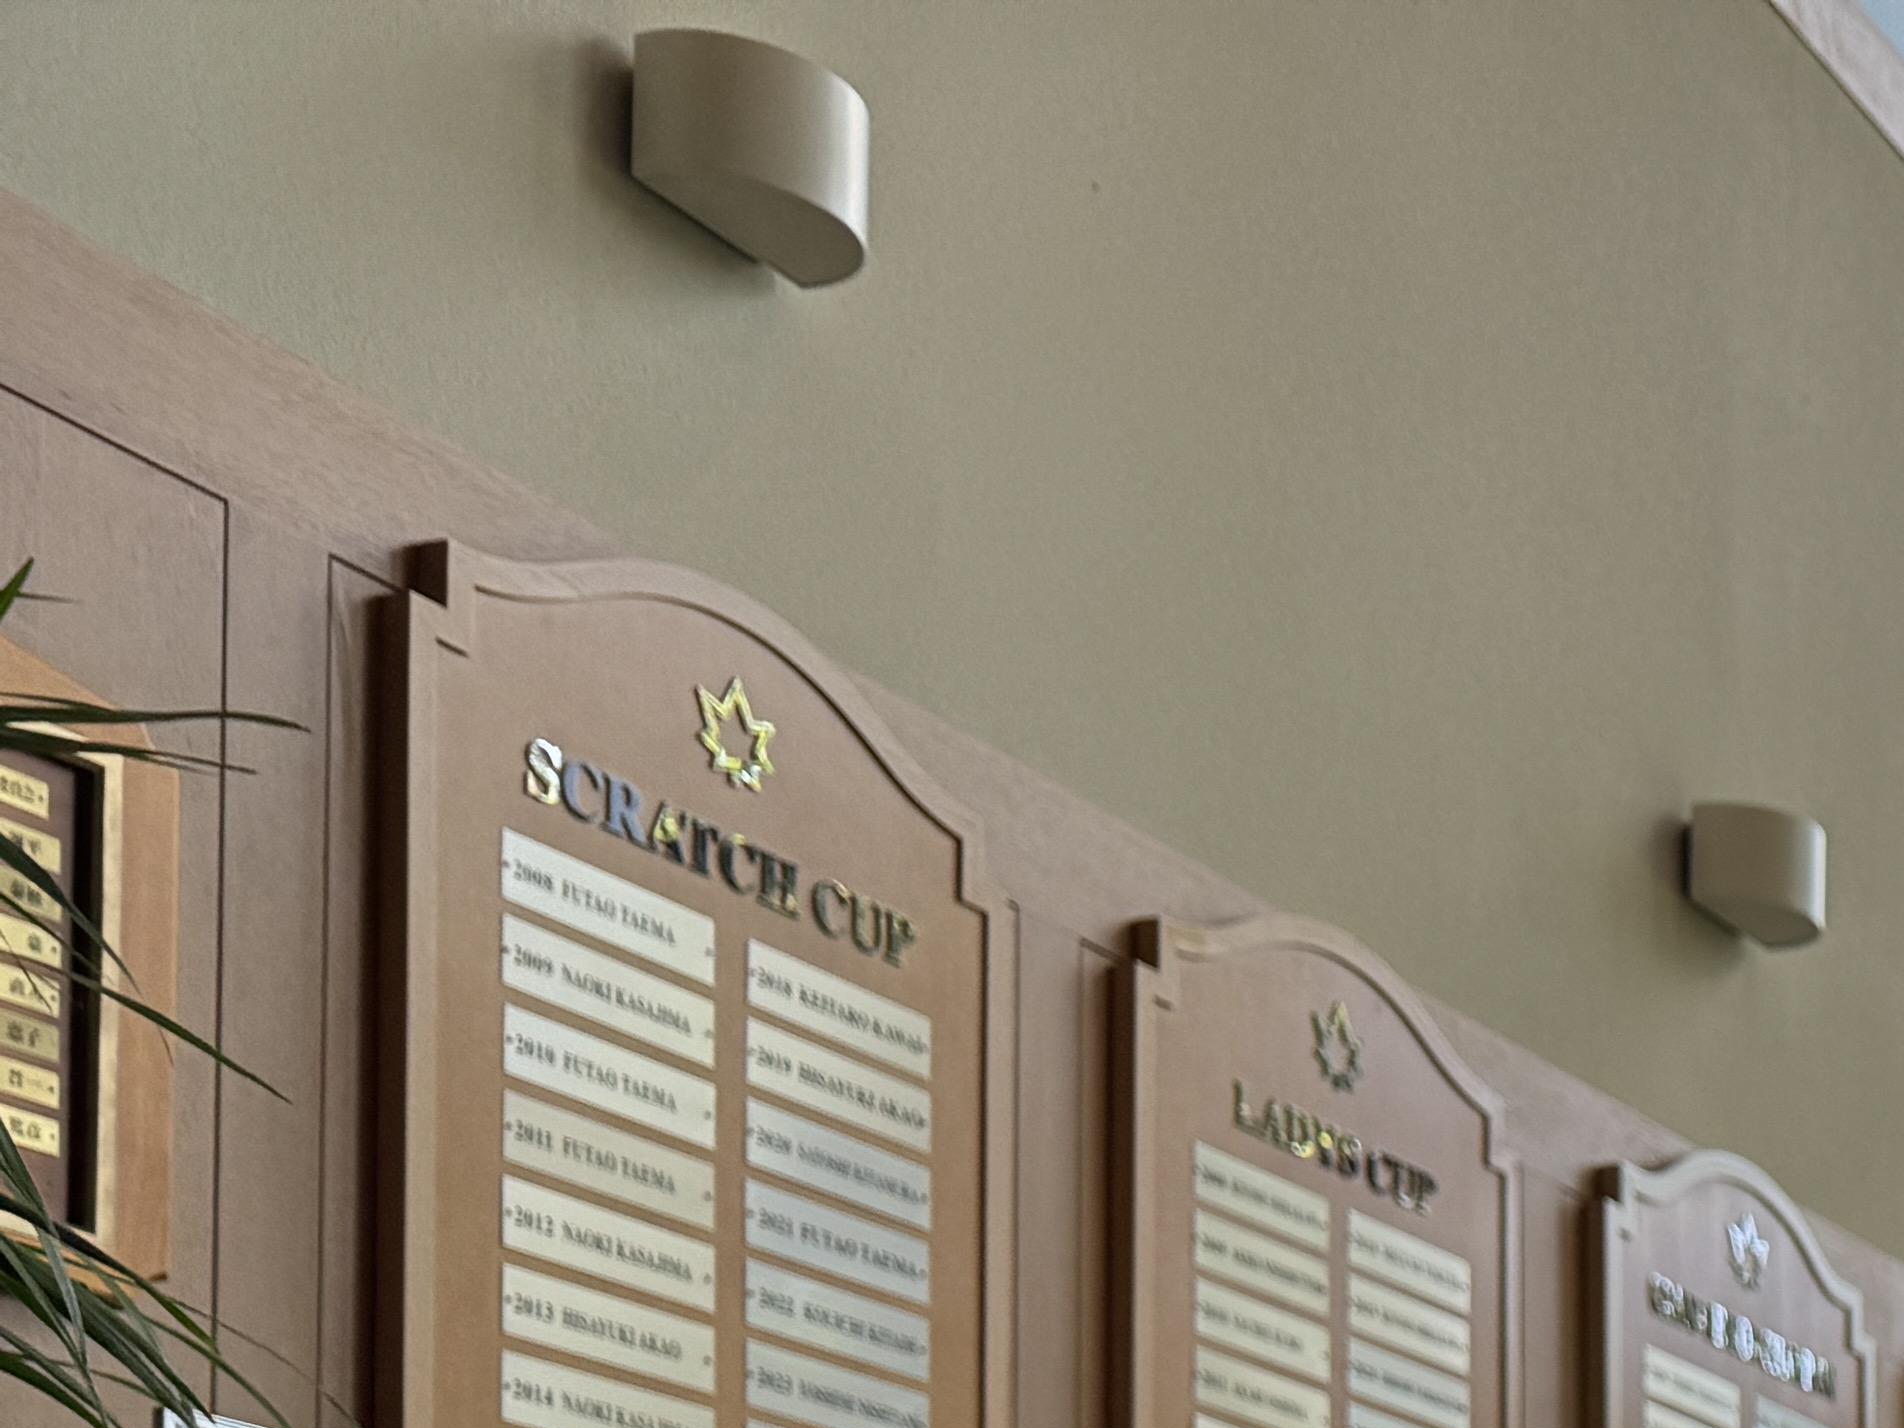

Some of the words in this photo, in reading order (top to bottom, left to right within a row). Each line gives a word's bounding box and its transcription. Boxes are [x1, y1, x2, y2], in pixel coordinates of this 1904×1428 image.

[524, 737, 801, 920] SCRATCH
[811, 878, 918, 968] CUP
[514, 1119, 553, 1152] 2011
[514, 1204, 553, 1238] 2012
[514, 1292, 553, 1323] 2013
[513, 1377, 553, 1408] 2014
